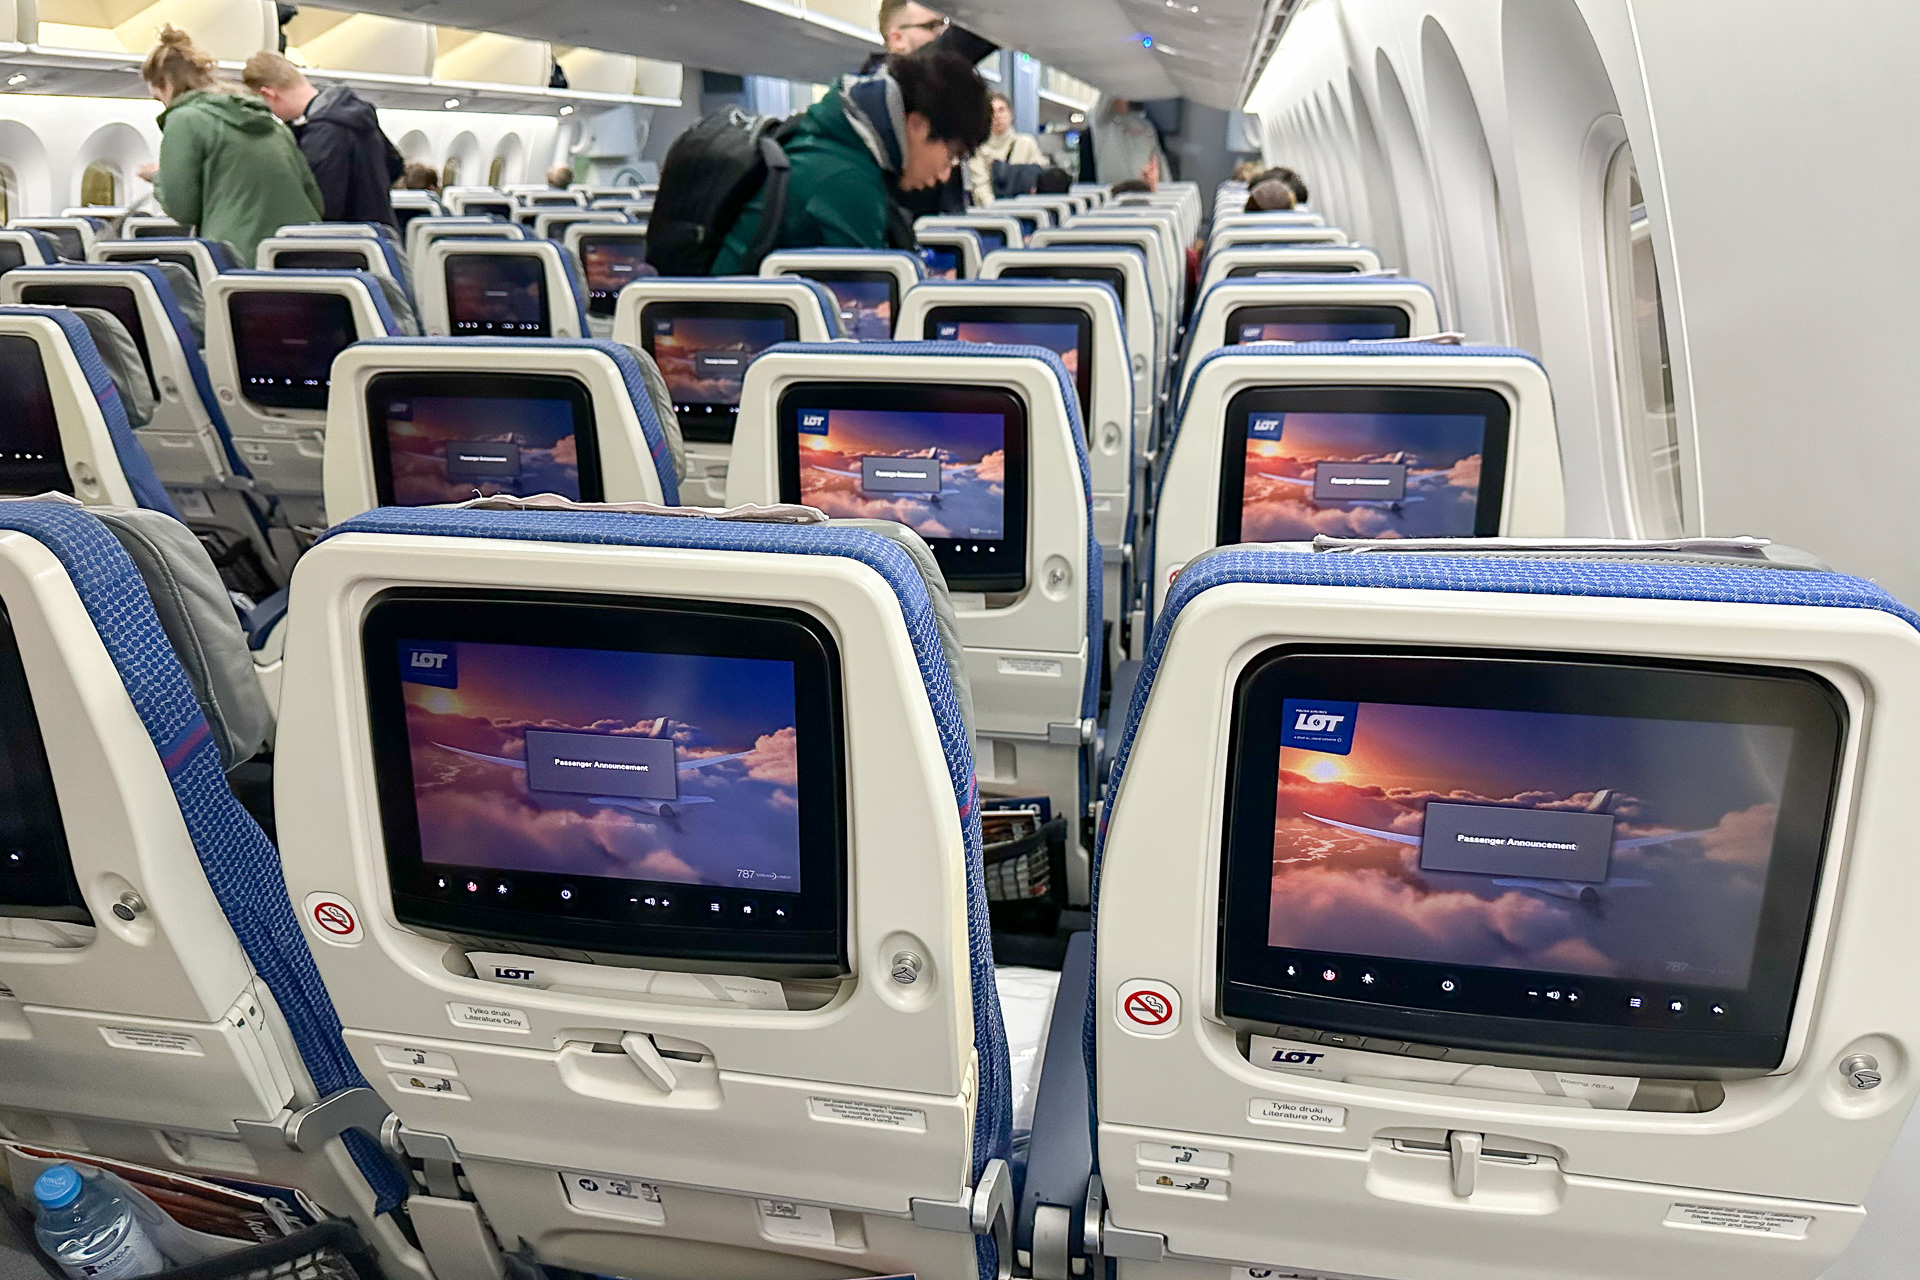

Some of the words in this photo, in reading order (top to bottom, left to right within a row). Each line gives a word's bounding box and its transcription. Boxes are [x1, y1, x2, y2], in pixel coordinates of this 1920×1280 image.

[804, 415, 825, 426] LOT
[1254, 420, 1279, 431] LOT
[411, 652, 448, 668] LOT
[1294, 714, 1344, 732] LOT
[555, 758, 592, 768] Passenger
[594, 761, 649, 772] Announcement
[1457, 834, 1505, 846] Passenger
[1507, 838, 1576, 850] Announcement
[737, 868, 755, 879] 787
[495, 967, 534, 980] LOT
[468, 1007, 489, 1016] Tylko
[464, 1014, 502, 1024] Literature
[503, 1018, 521, 1027] Only
[1272, 1050, 1325, 1064] LOT
[1272, 1102, 1297, 1111] Tylko
[1299, 1105, 1323, 1114] druki
[1262, 1109, 1308, 1120] Literature
[1310, 1114, 1333, 1123] Only
[42, 1177, 66, 1187] KINGA
[97, 1245, 130, 1270] KINGA
